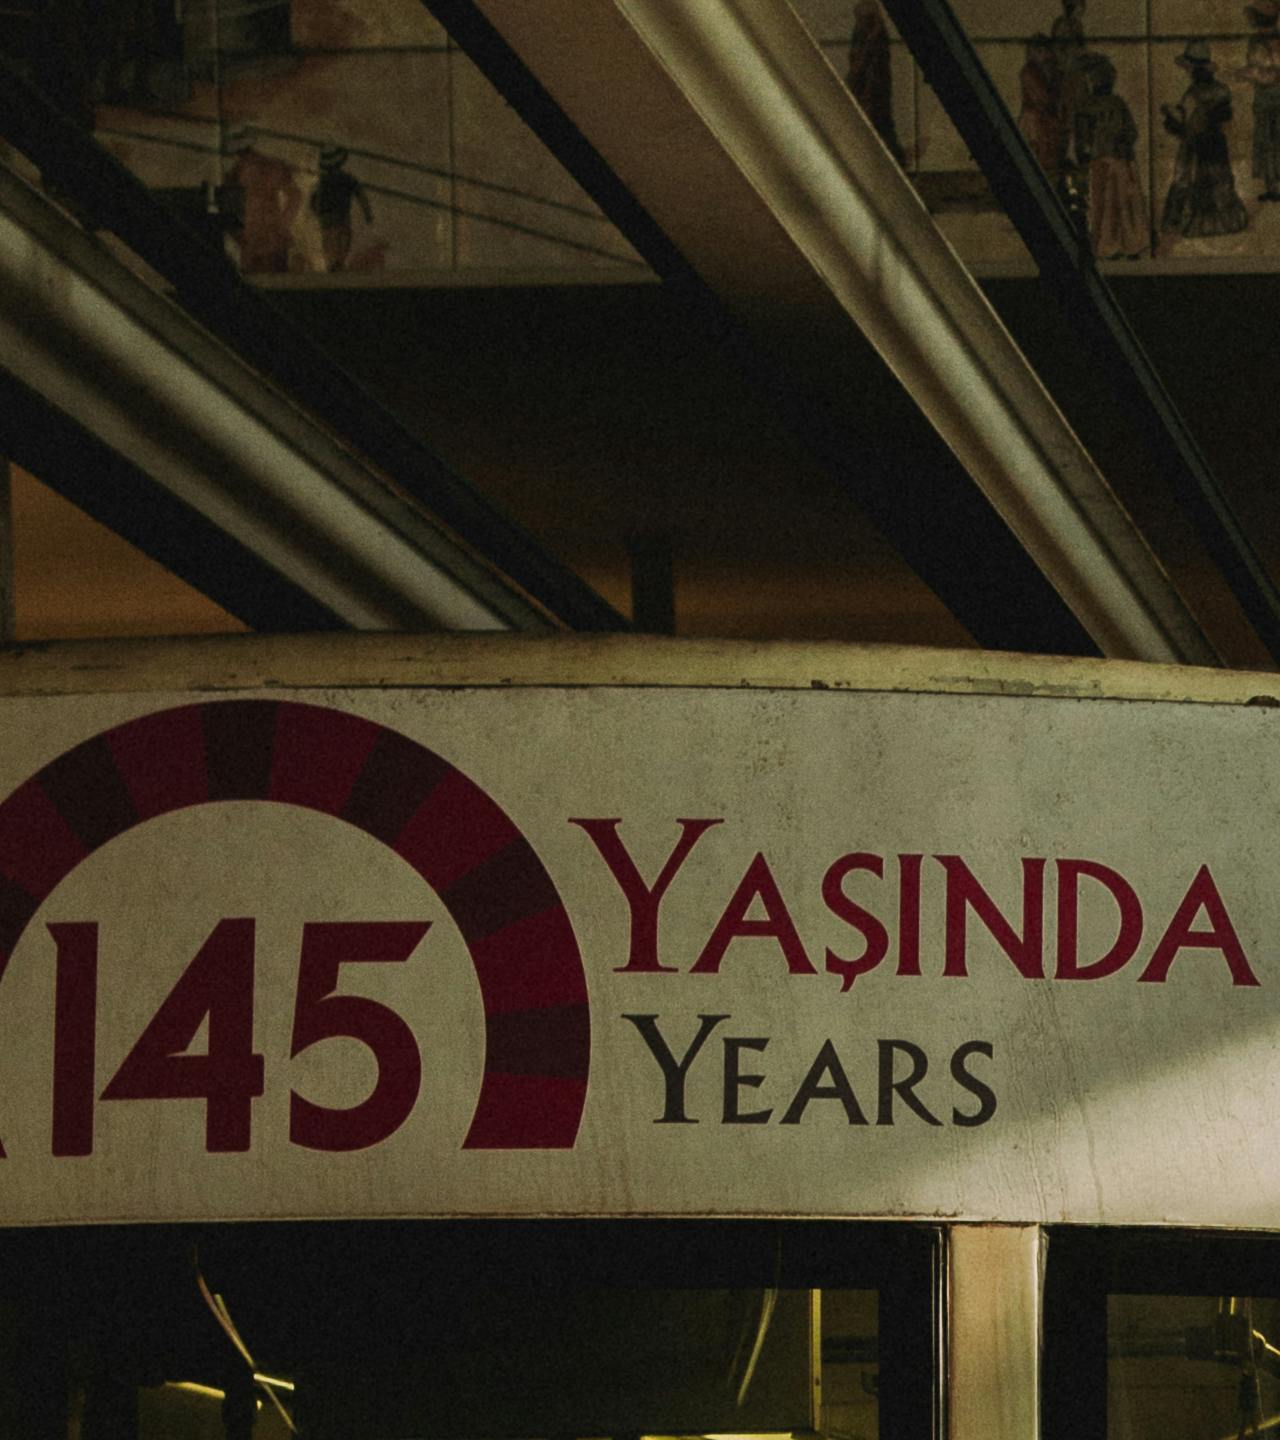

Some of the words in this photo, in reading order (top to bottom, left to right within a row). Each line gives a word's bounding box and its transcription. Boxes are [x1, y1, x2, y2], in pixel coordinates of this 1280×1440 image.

[567, 817, 1262, 994] YAŞINDA
[45, 917, 434, 1158] 145
[620, 1013, 998, 1128] YEARS
